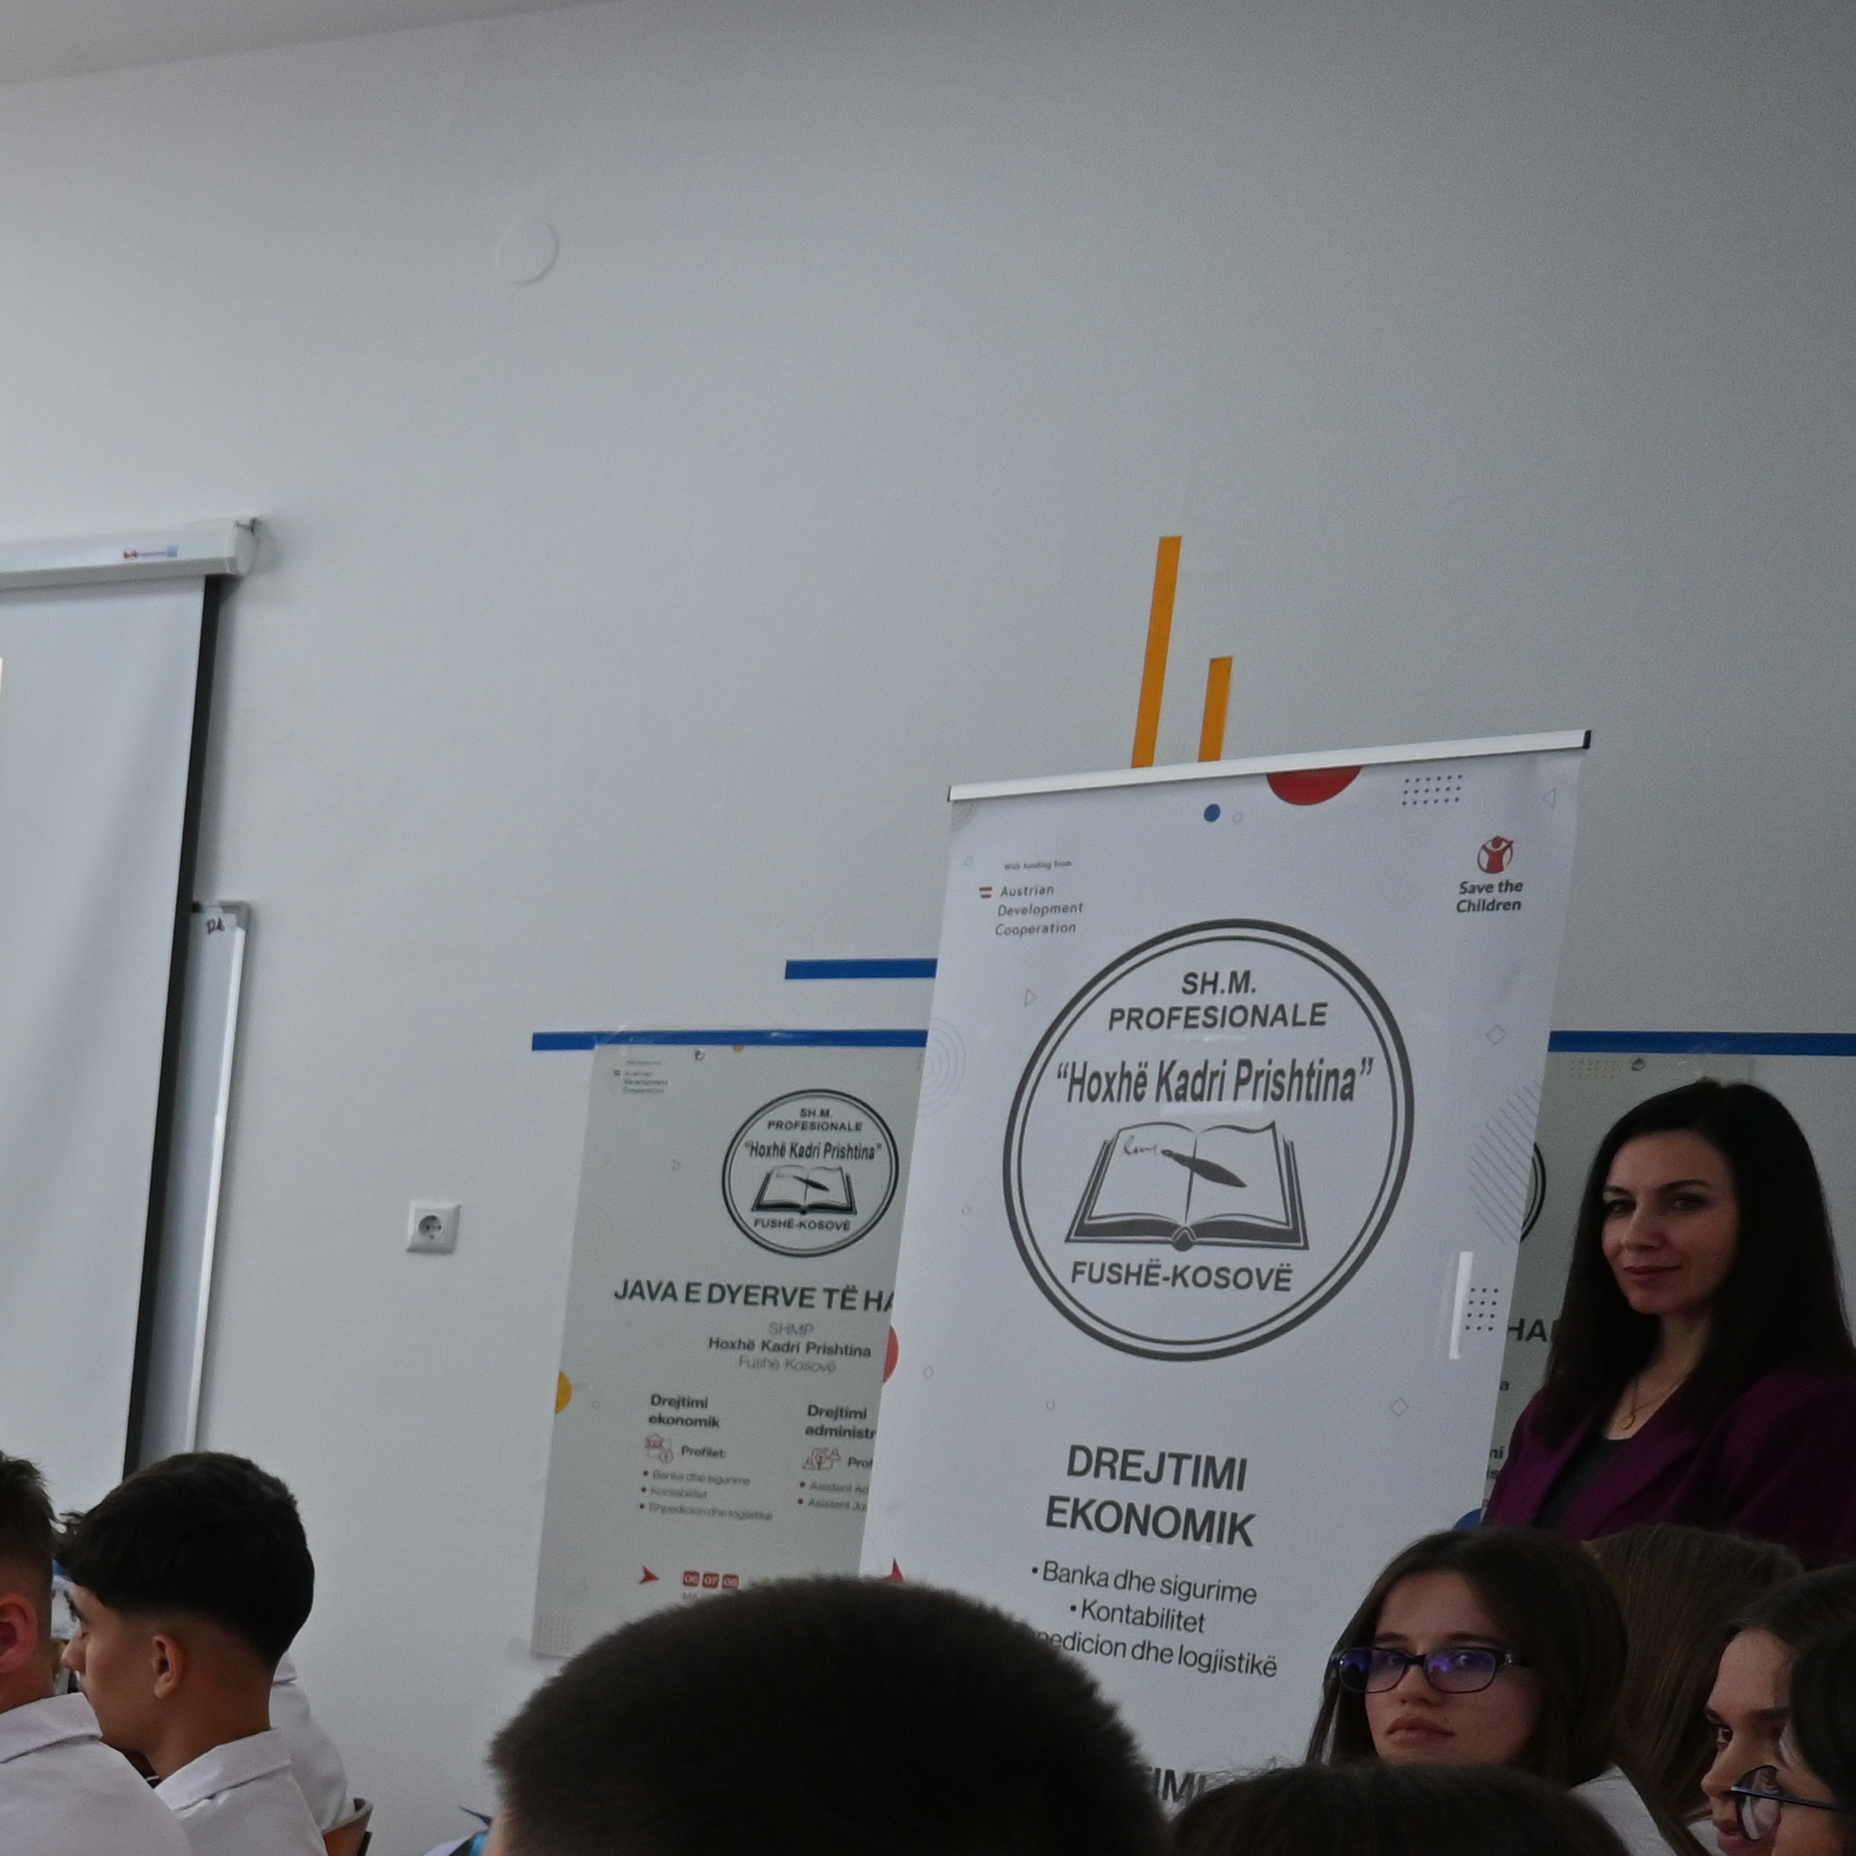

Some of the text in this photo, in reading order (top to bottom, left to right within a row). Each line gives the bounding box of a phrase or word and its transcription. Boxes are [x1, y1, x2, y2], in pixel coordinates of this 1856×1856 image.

[1000, 885, 1055, 898] Austrian
[1458, 879, 1524, 895] Save the
[997, 902, 1084, 918] Development
[1456, 898, 1522, 913] Children
[995, 921, 1077, 938] Cooperation
[1181, 969, 1257, 995] SH.M.
[1108, 1002, 1329, 1031] PROFESIONALE
[1155, 1059, 1228, 1103] Kadri
[799, 1107, 833, 1119] SH.M.
[767, 1119, 865, 1132] PROFESIONALE
[789, 1141, 821, 1159] Kadri
[1070, 1258, 1294, 1293] FUSHË-KOSOVË
[614, 1278, 679, 1303] JAVA
[685, 1281, 703, 1304] E
[707, 1282, 817, 1310] DYERVE
[822, 1284, 860, 1312] TË
[767, 1321, 815, 1337] SHMP
[707, 1336, 873, 1358] Hoxhë Kadri Prishtina
[649, 1392, 709, 1410] Drejtimi
[647, 1412, 721, 1429] ekonomik
[807, 1403, 868, 1421] Drejtimi
[1066, 1443, 1248, 1491] DREJTIMI
[1045, 1494, 1258, 1547] EKONOMIK
[1042, 1560, 1258, 1605] Banka dhe sigurime
[1080, 1598, 1207, 1634] Kontabilitet
[1130, 1638, 1175, 1665] dhe
[1177, 1643, 1279, 1678] logjistikë
